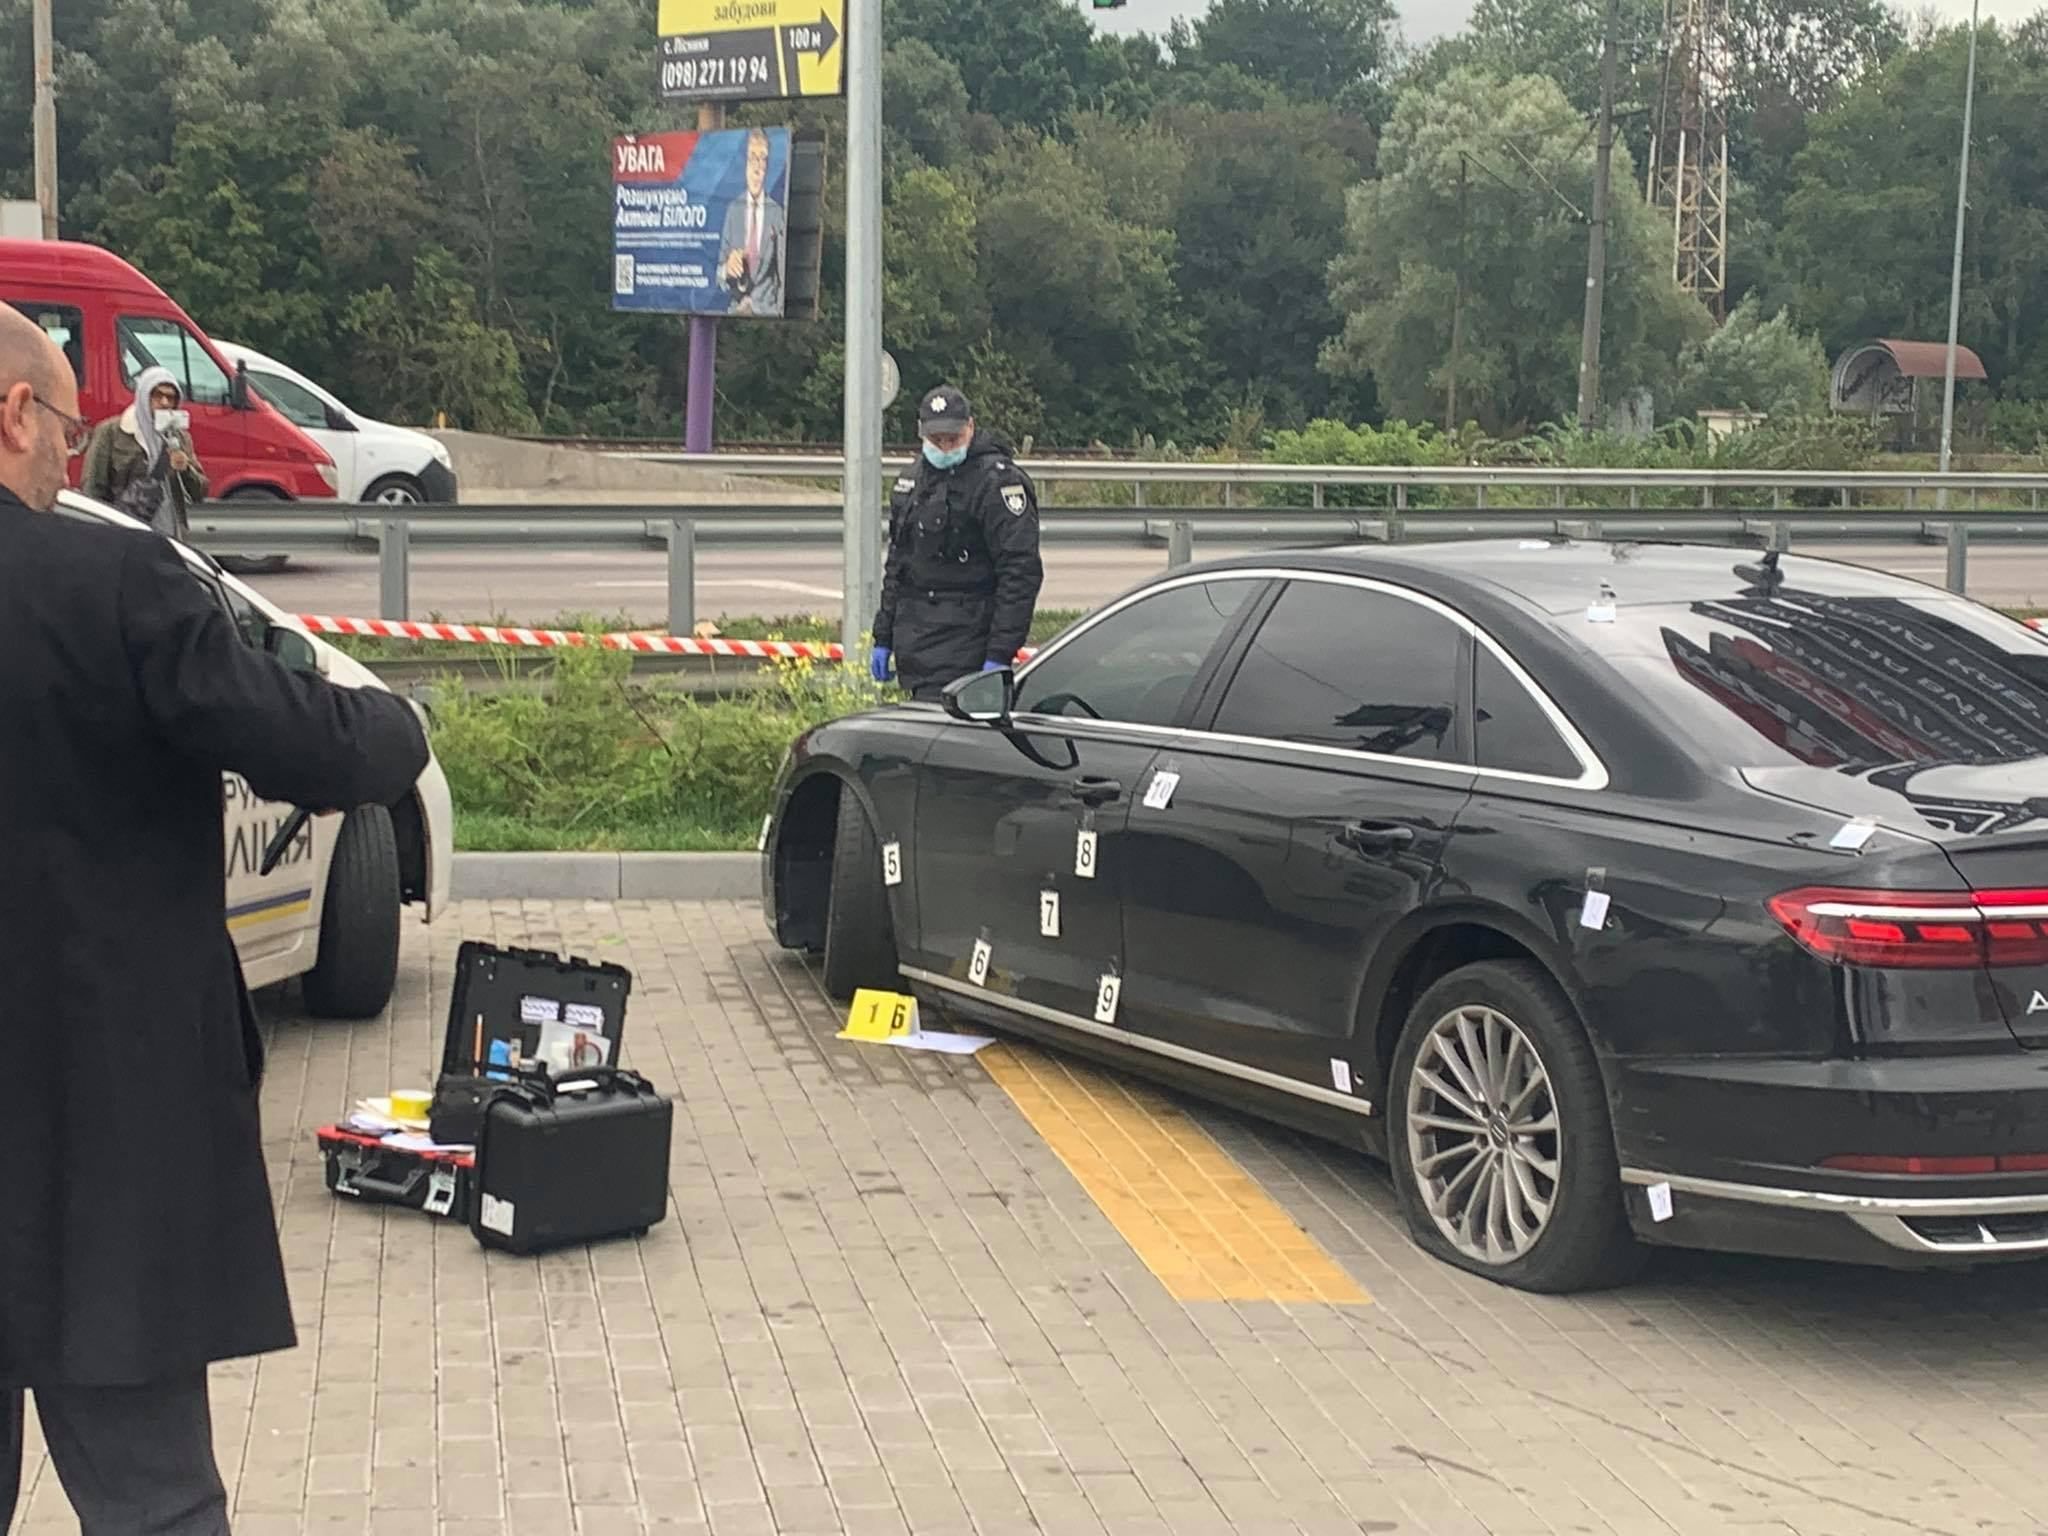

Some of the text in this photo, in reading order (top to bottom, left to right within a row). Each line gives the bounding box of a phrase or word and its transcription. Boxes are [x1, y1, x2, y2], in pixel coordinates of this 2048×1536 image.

[714, 2, 777, 24] забудови
[789, 28, 810, 49] 100
[662, 55, 768, 89] (098) 271 19 94
[617, 144, 665, 173] УВАГА
[888, 851, 898, 876] 5
[1080, 839, 1092, 867] 8
[1045, 901, 1055, 927] 7
[974, 949, 986, 974] 6
[1101, 984, 1114, 1013] 9
